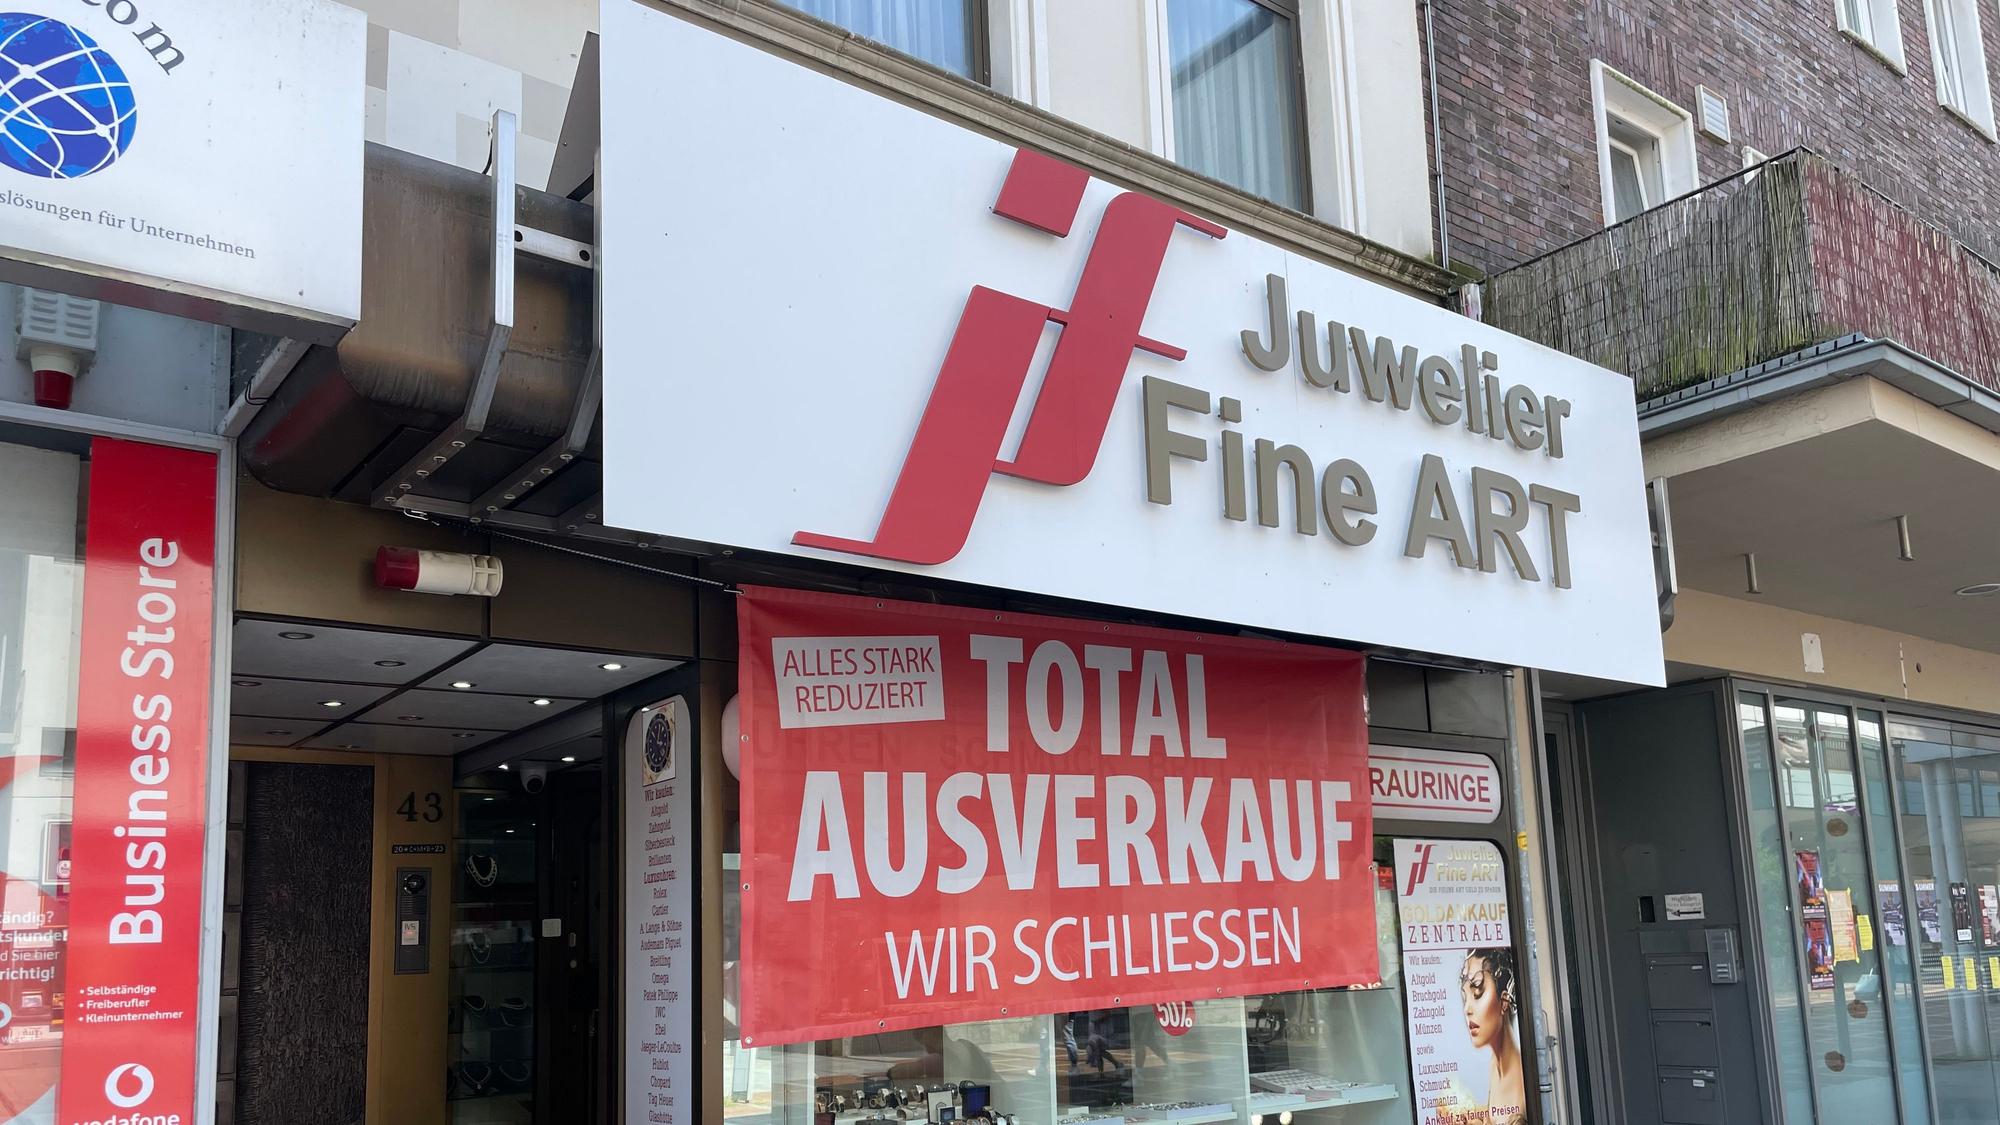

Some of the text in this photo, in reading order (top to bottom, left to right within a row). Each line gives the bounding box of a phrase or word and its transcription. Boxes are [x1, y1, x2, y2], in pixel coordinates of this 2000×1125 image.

[82, 0, 185, 76] om
[98, 210, 126, 229] für
[131, 217, 256, 259] Unternehmen
[1241, 273, 1571, 459] Juwelier
[1142, 374, 1582, 590] Fine ART
[783, 647, 935, 677] ALLES STARK
[795, 681, 928, 713] REDUZIERT
[970, 634, 1227, 759] TOTAL
[109, 537, 179, 944] Business Store
[1368, 767, 1492, 803] RAURINGE
[396, 791, 443, 823] 43
[787, 771, 1353, 902] AUSVERKAUF
[1436, 863, 1499, 881] Fine ART
[1401, 903, 1506, 923] GOLDANKAUF
[1408, 923, 1504, 943] ZENTRALE
[12, 950, 31, 961] Sie
[34, 950, 60, 961] hier
[886, 907, 1302, 999] WIR SCHLIESSEN
[1411, 973, 1436, 986] Altgold
[86, 985, 157, 996] Selbständige
[1412, 989, 1447, 1003] Bruchgold
[86, 998, 150, 1009] Freiberufler
[1413, 1005, 1445, 1019] Zahngold
[86, 1011, 184, 1023] Kleinunternehmer
[1415, 1023, 1442, 1035] Münzen
[1416, 1045, 1434, 1056] sowie
[1418, 1061, 1458, 1076] Luxusuhren
[1420, 1077, 1451, 1092] Schmuck
[1421, 1095, 1458, 1109] Diamanten
[1491, 1105, 1520, 1116] Preisen
